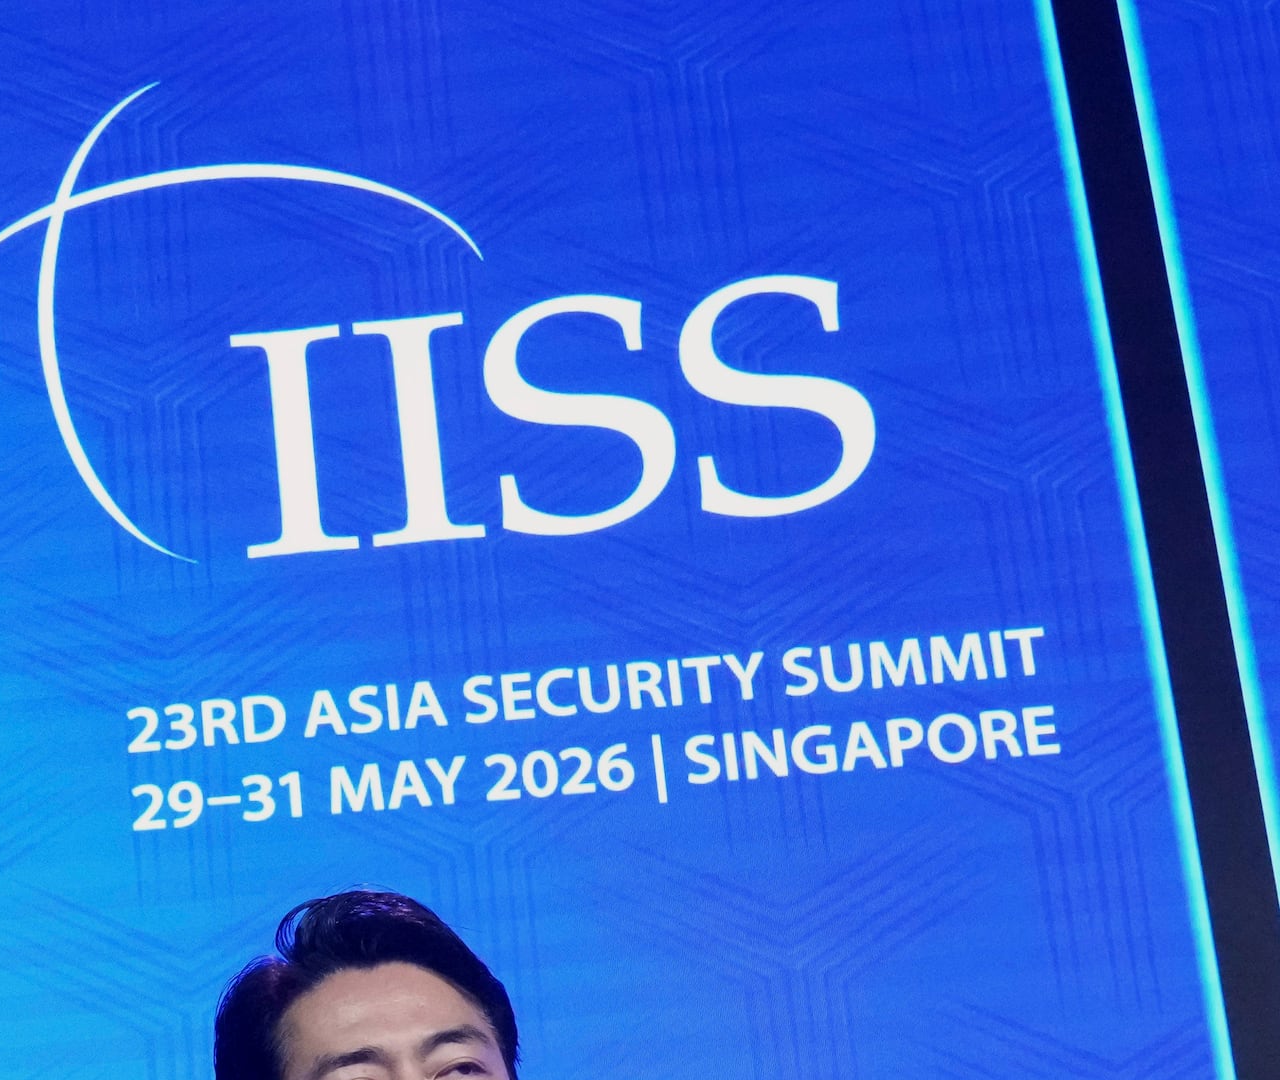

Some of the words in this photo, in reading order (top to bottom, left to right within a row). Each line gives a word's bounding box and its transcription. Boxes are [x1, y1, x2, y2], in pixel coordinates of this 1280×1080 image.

[229, 275, 877, 560] IISS
[127, 695, 287, 753] 23RD
[304, 681, 448, 738] ASIA
[463, 652, 764, 724] SECURITY
[782, 627, 1044, 697] SUMMIT
[330, 756, 466, 814] MAY
[484, 743, 635, 801] 2026
[684, 706, 1061, 785] SINGAPORE
